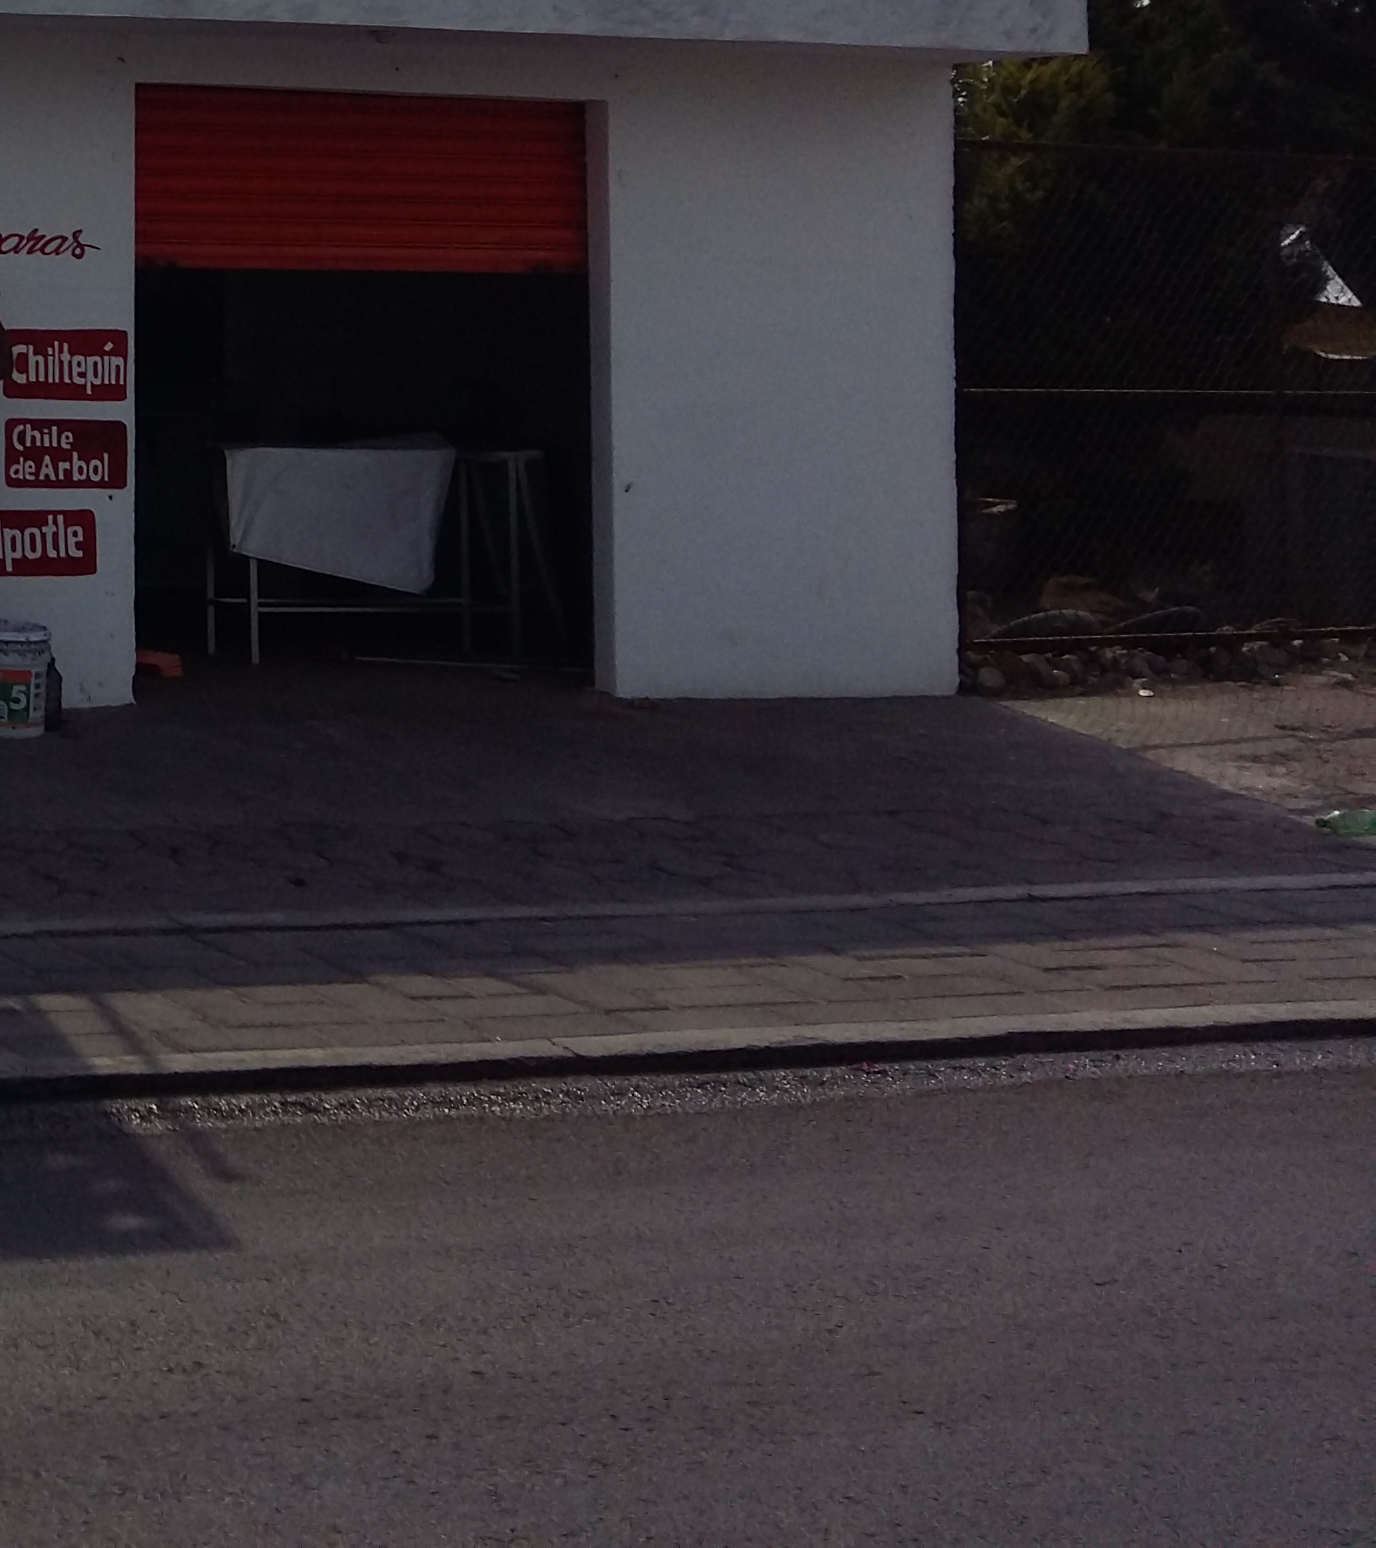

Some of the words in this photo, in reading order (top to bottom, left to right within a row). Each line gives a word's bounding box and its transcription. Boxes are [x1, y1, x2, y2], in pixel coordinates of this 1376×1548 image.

[10, 340, 125, 396] Chiltepín
[12, 423, 74, 451] Chile
[8, 684, 28, 711] 5
